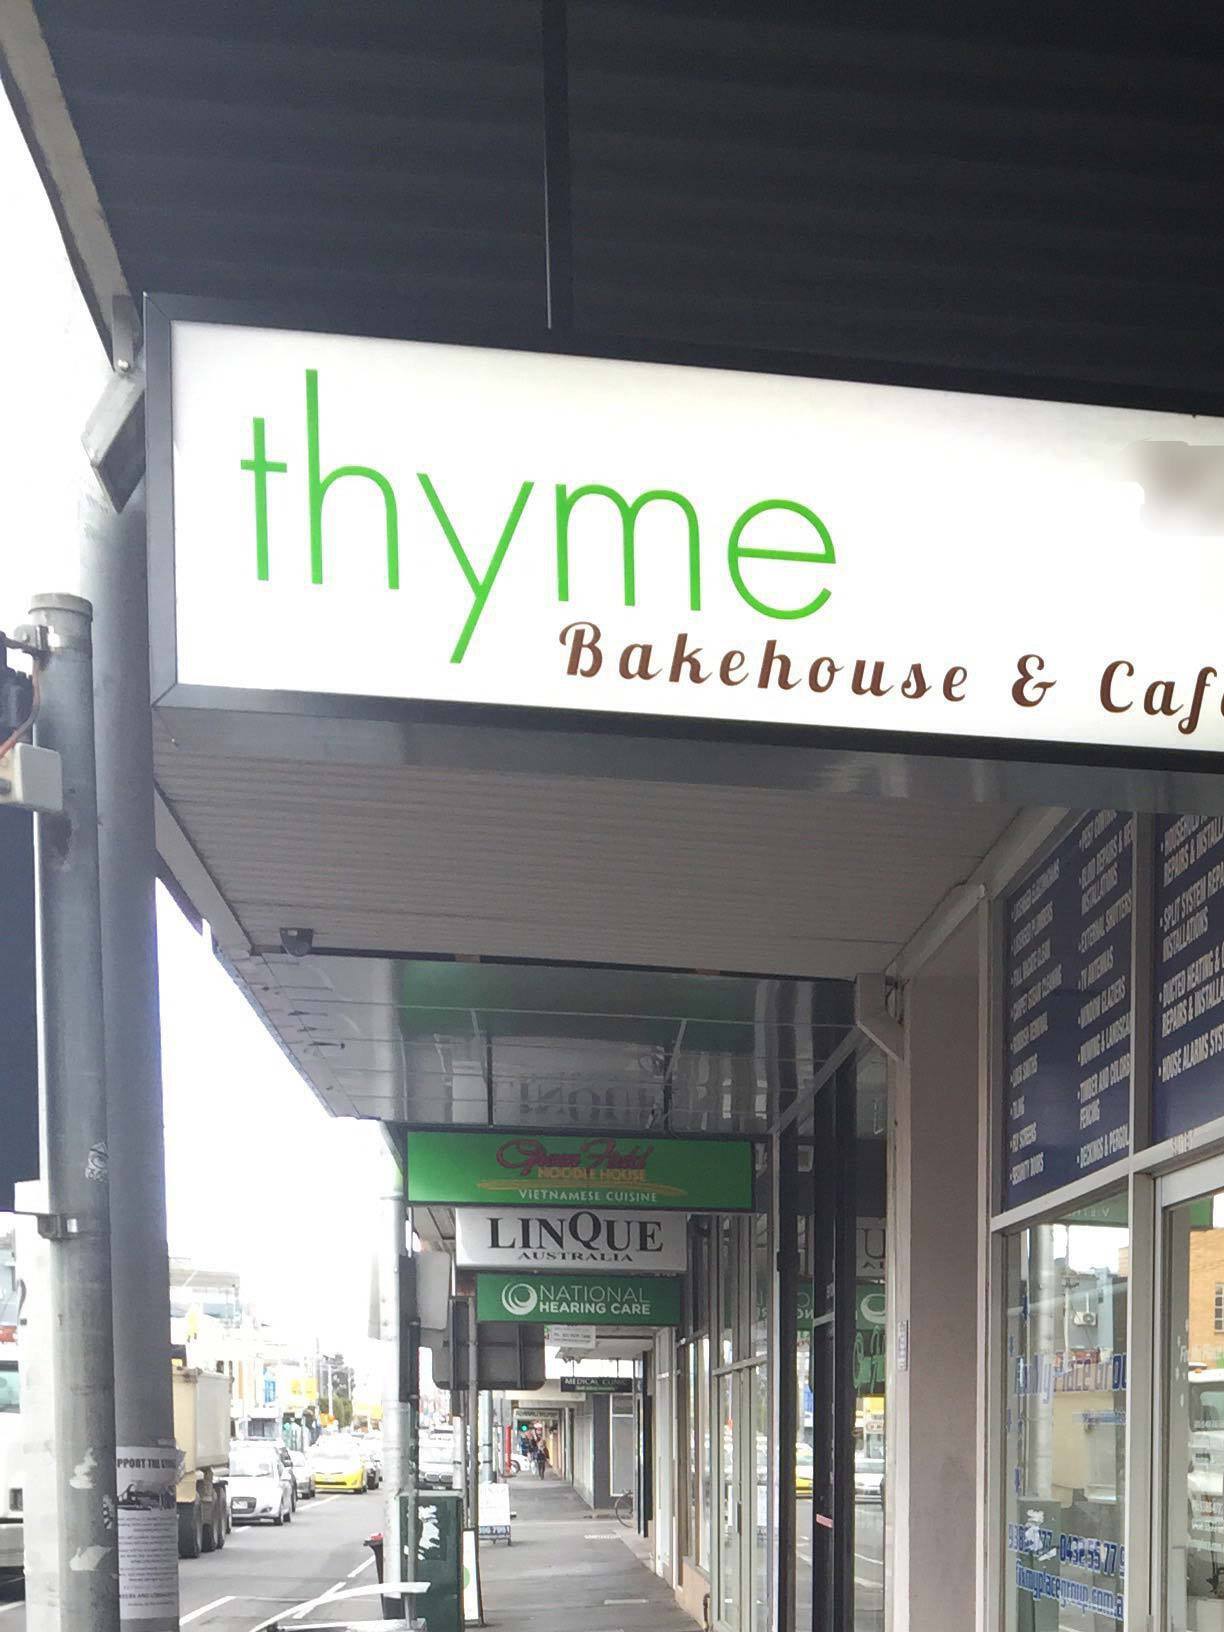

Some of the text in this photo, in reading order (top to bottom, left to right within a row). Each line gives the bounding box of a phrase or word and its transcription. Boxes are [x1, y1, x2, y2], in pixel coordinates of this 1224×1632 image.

[240, 368, 836, 664] thyme
[559, 621, 968, 702] Bakehouse
[1011, 653, 1057, 708] &
[605, 1190, 657, 1202] CUISINE
[487, 1210, 664, 1252] LINQUE
[518, 1251, 634, 1263] AUSTRALIA
[539, 1284, 651, 1303] NATIONAL
[539, 1301, 651, 1316] HEARING CARE
